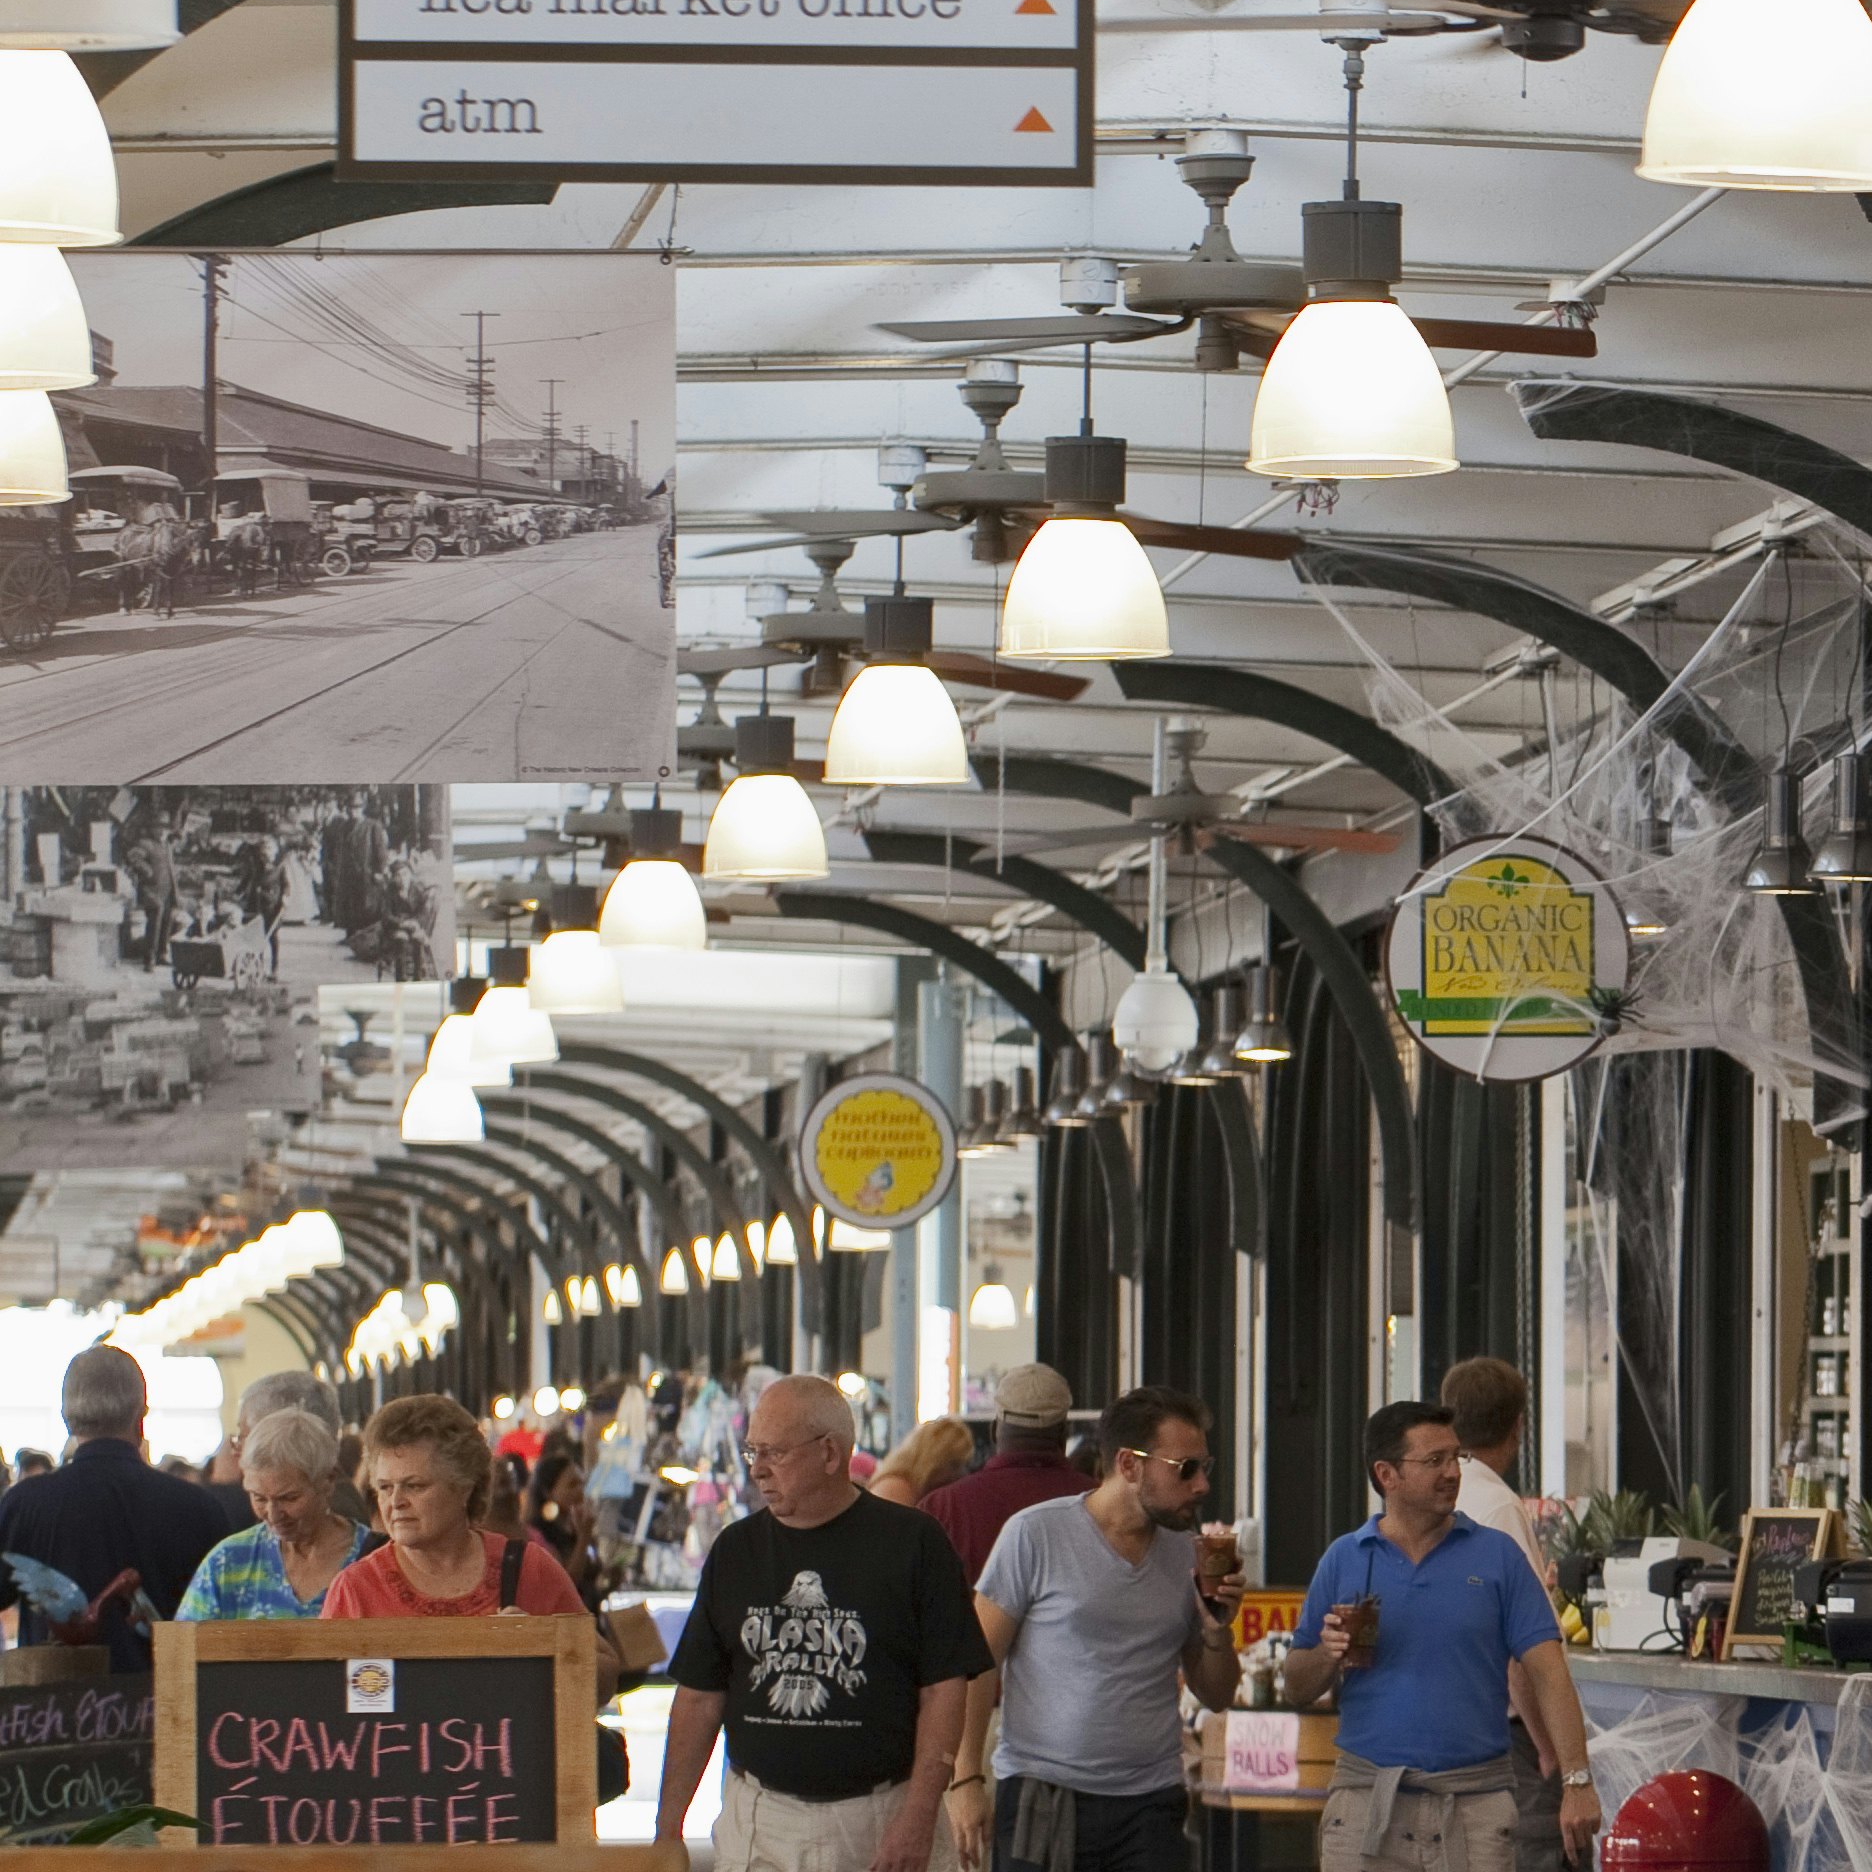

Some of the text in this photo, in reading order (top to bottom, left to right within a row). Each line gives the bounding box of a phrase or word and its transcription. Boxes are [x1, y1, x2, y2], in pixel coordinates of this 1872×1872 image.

[418, 87, 544, 135] atm
[1432, 904, 1583, 933] ORGANIC
[1432, 935, 1585, 973] BANANA
[740, 1615, 868, 1669] ALASKA
[764, 1651, 845, 1679] RALLY
[783, 1678, 815, 1690] 2005
[208, 1711, 513, 1778] CRAWFISH
[1234, 1718, 1287, 1747] SNOW
[1232, 1749, 1290, 1778] BALLS
[212, 1775, 521, 1848] ÉTOUFFÉE
